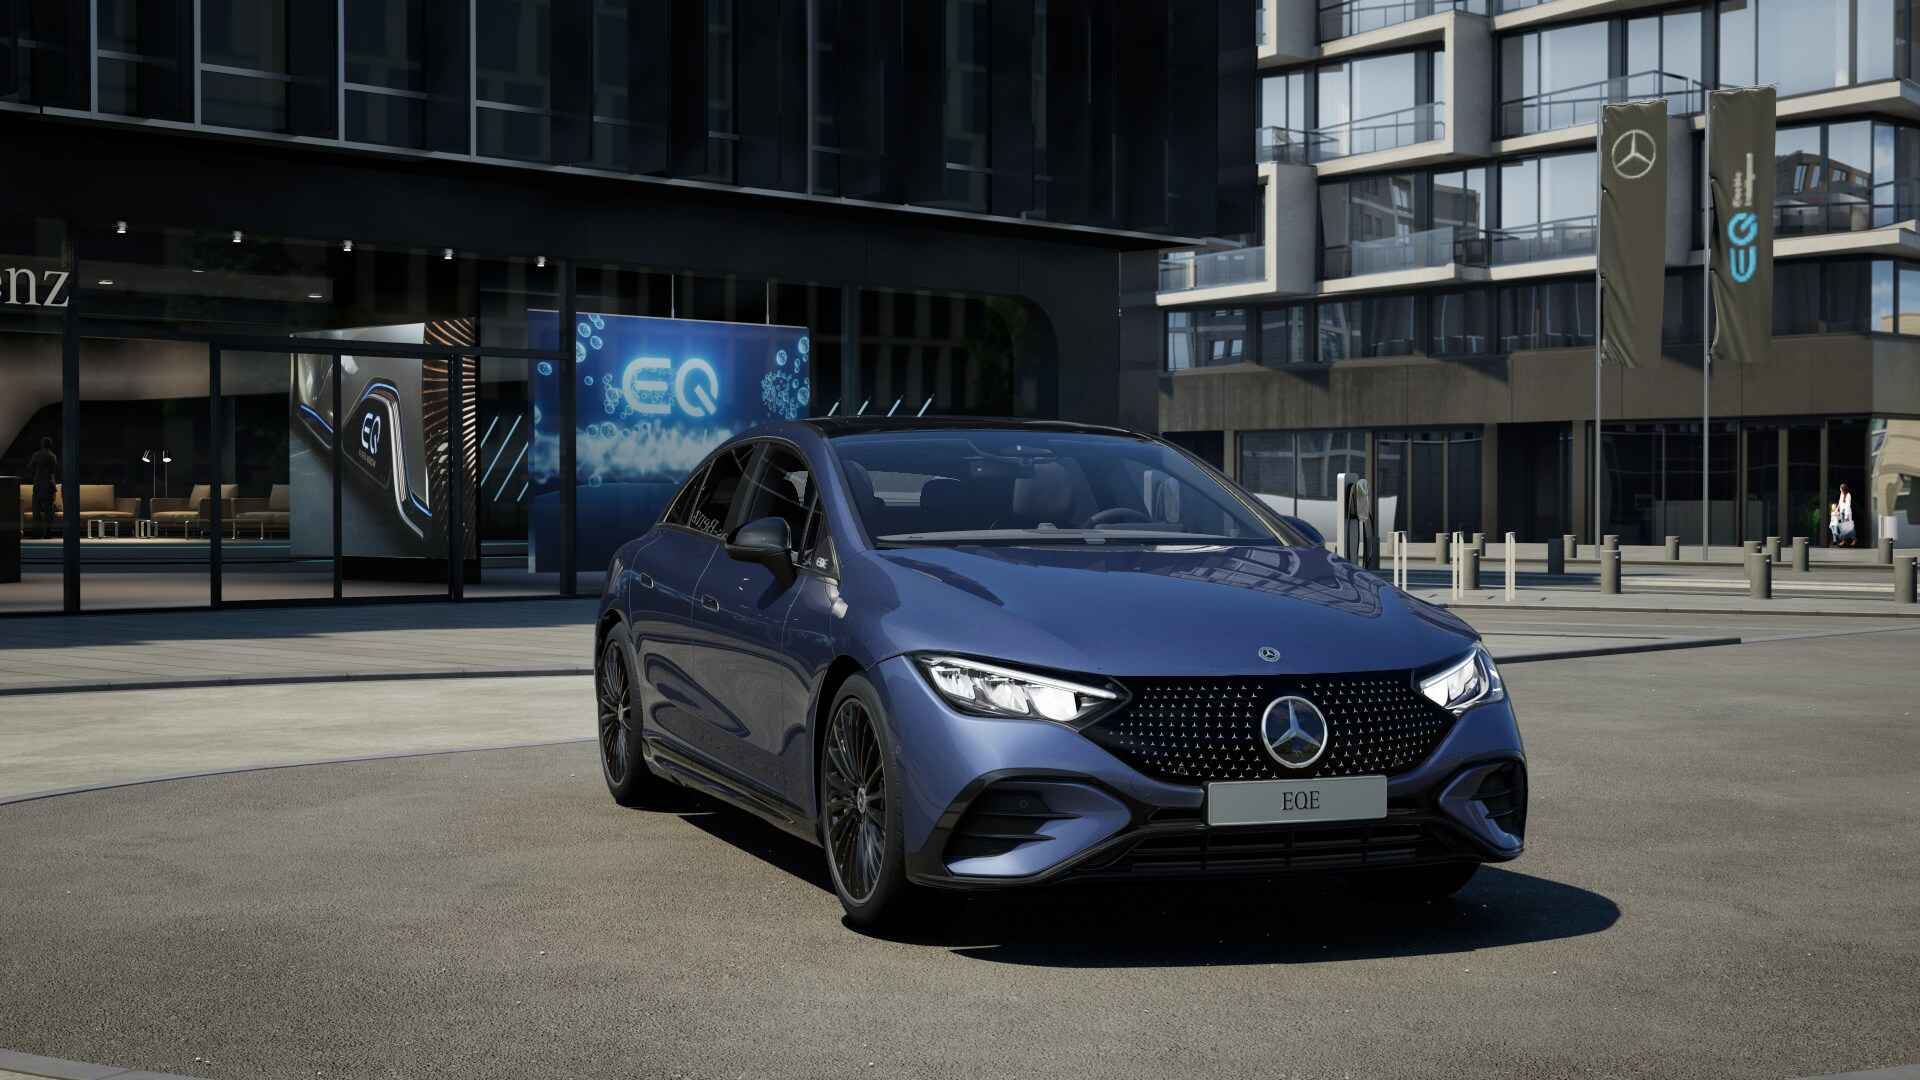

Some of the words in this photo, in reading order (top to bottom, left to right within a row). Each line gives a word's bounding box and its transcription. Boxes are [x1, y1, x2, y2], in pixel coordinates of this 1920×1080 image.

[1728, 212, 1758, 283] EQ
[0, 268, 70, 307] nz
[622, 357, 718, 417] EQ
[361, 412, 381, 455] EQ
[1281, 790, 1320, 811] EQE
